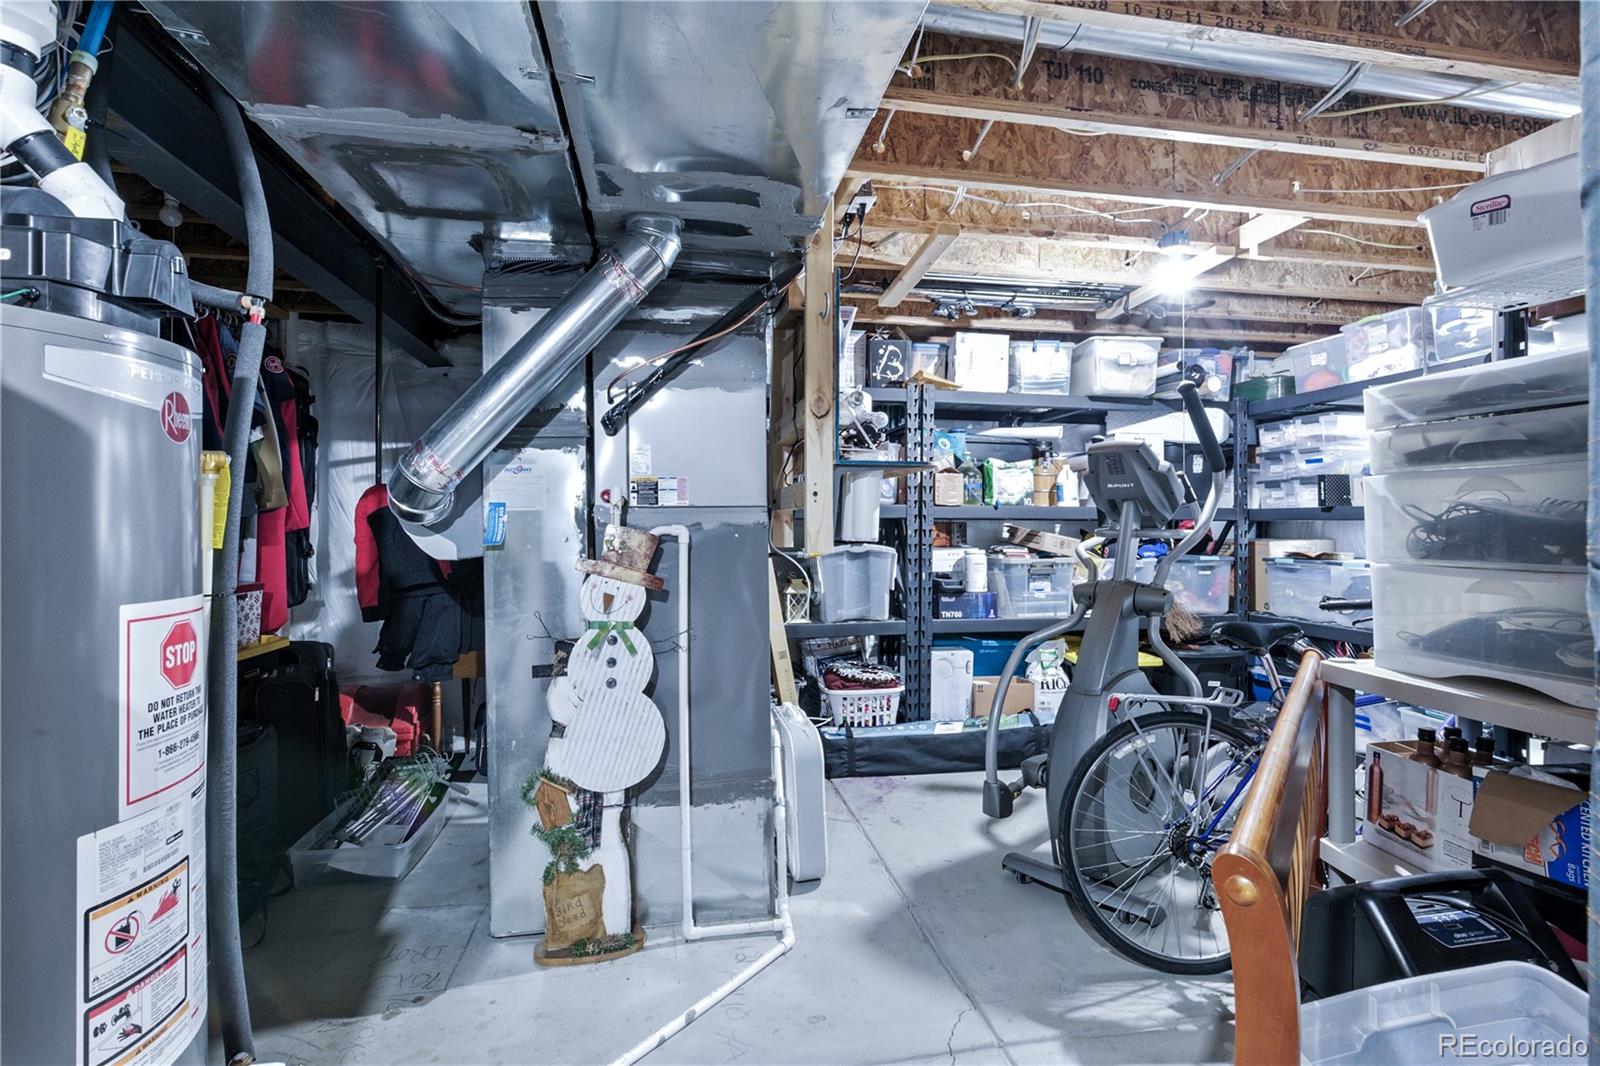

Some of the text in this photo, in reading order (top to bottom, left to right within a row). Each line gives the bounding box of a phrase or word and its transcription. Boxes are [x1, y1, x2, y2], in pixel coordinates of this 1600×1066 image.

[1215, 15, 1265, 34] 20:29
[1041, 60, 1104, 84] TJI 110
[1171, 71, 1217, 87] INSTALL
[1222, 77, 1245, 91] PER
[1210, 87, 1233, 99] LES
[941, 610, 963, 618] TN760
[165, 640, 196, 669] STOP
[147, 701, 159, 713] DO
[160, 696, 175, 709] NOT
[175, 688, 195, 703] RETURN
[153, 706, 177, 723] WATER
[178, 698, 196, 714] HEATER
[138, 726, 154, 740] THE
[157, 717, 178, 734] PLACE
[179, 713, 187, 725] OF
[1566, 862, 1576, 883] Bags
[136, 875, 170, 899] WARNING
